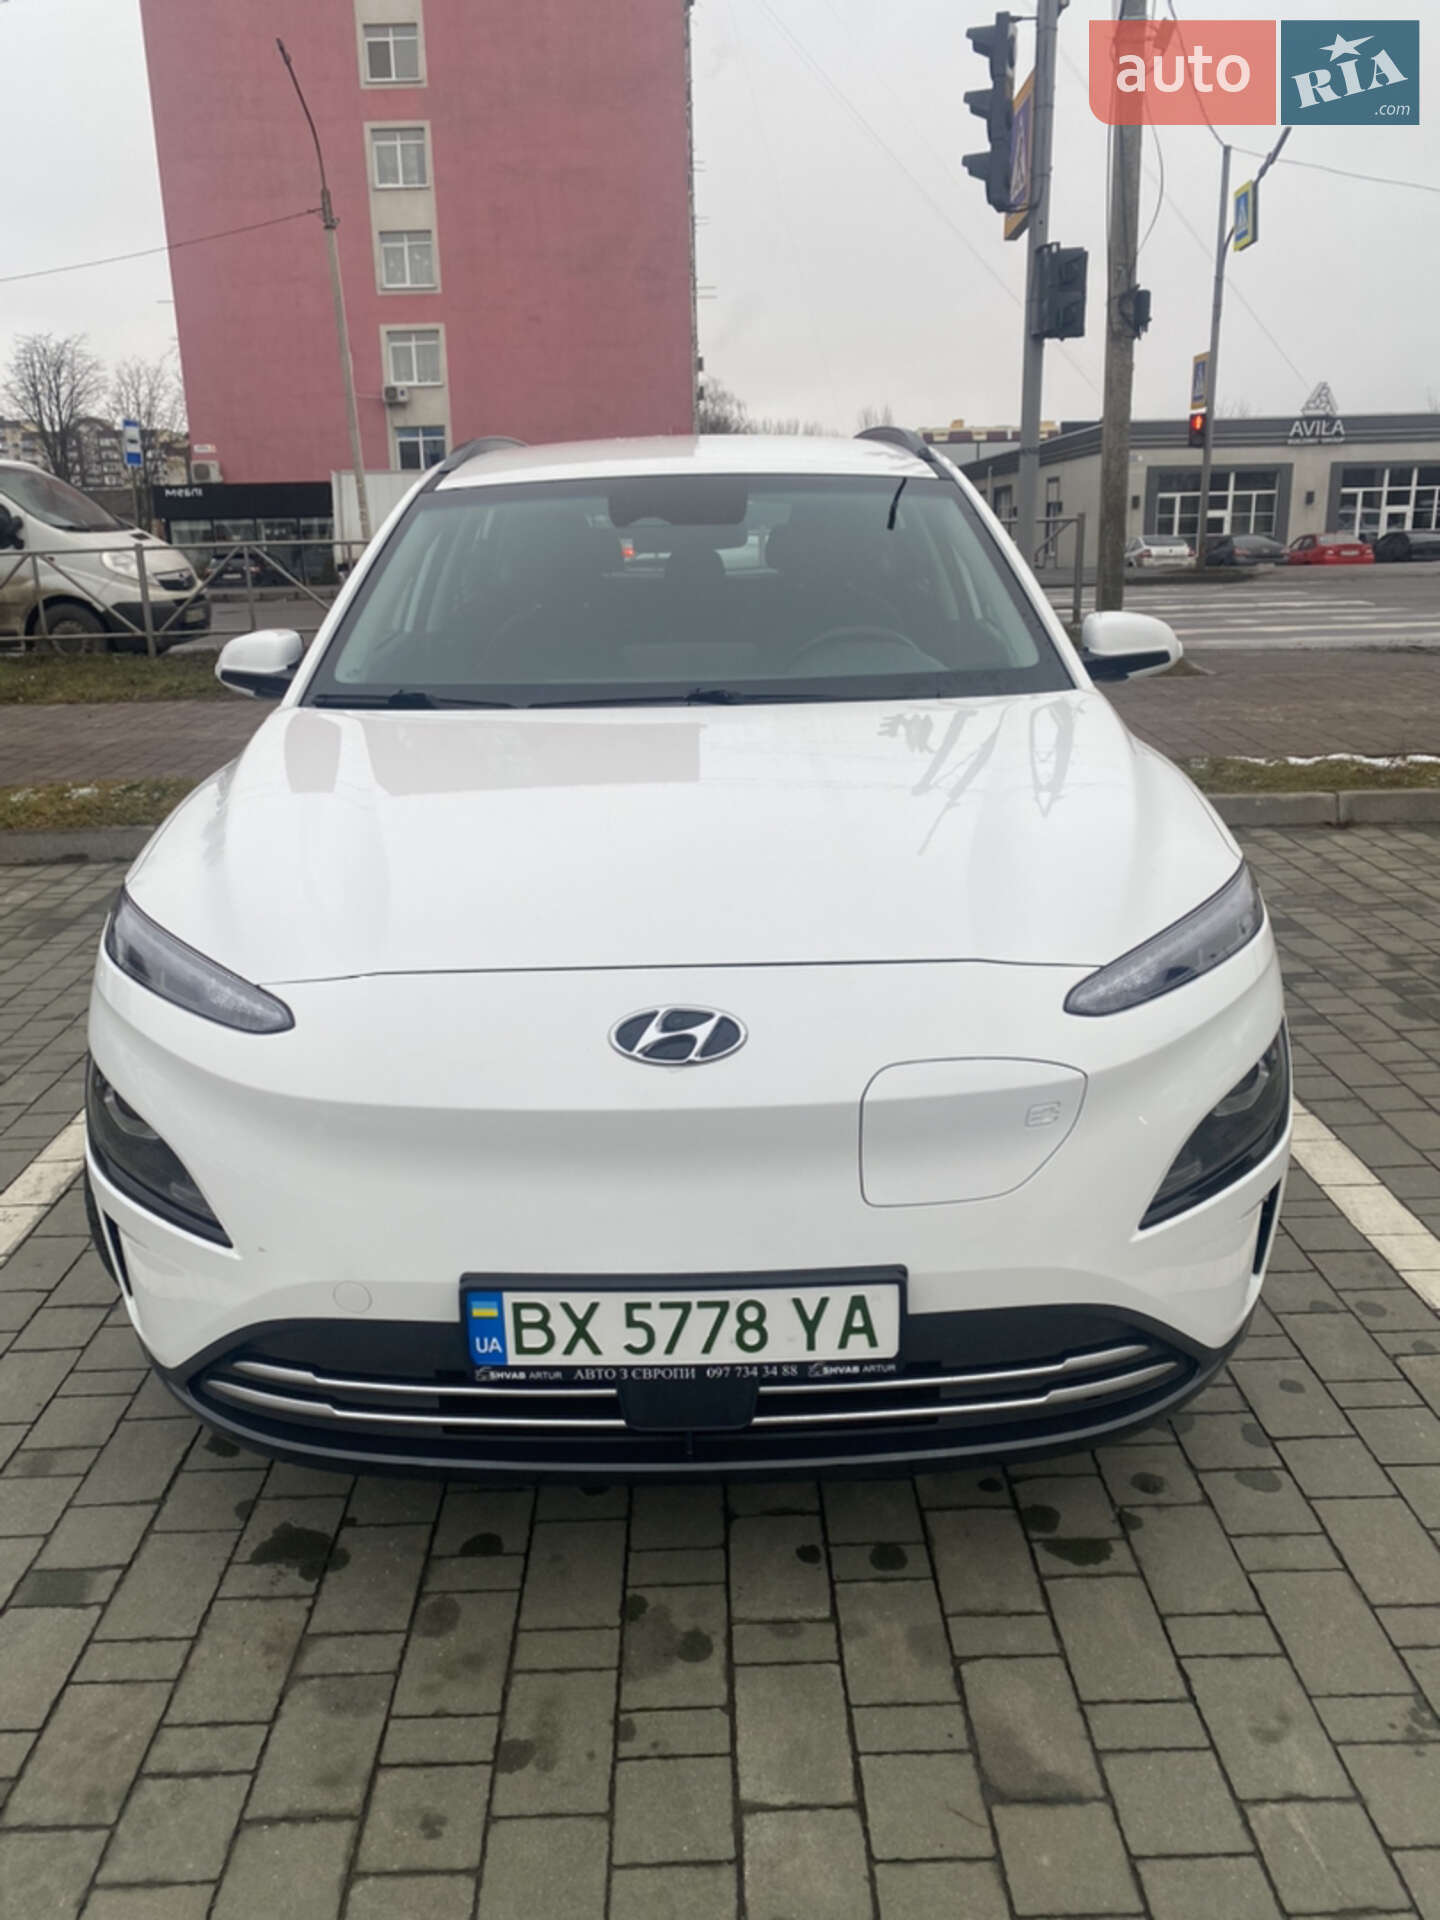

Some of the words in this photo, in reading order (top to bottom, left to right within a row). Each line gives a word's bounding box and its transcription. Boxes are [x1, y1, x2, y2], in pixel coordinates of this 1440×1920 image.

[512, 1302, 603, 1355] BX
[623, 1300, 769, 1355] 5778
[792, 1295, 879, 1351] YA
[475, 1337, 502, 1353] UA
[574, 1368, 617, 1380] АВТО
[706, 1367, 731, 1378] 097
[735, 1366, 759, 1378] 734
[762, 1366, 778, 1376] 34
[782, 1365, 798, 1376] 88
